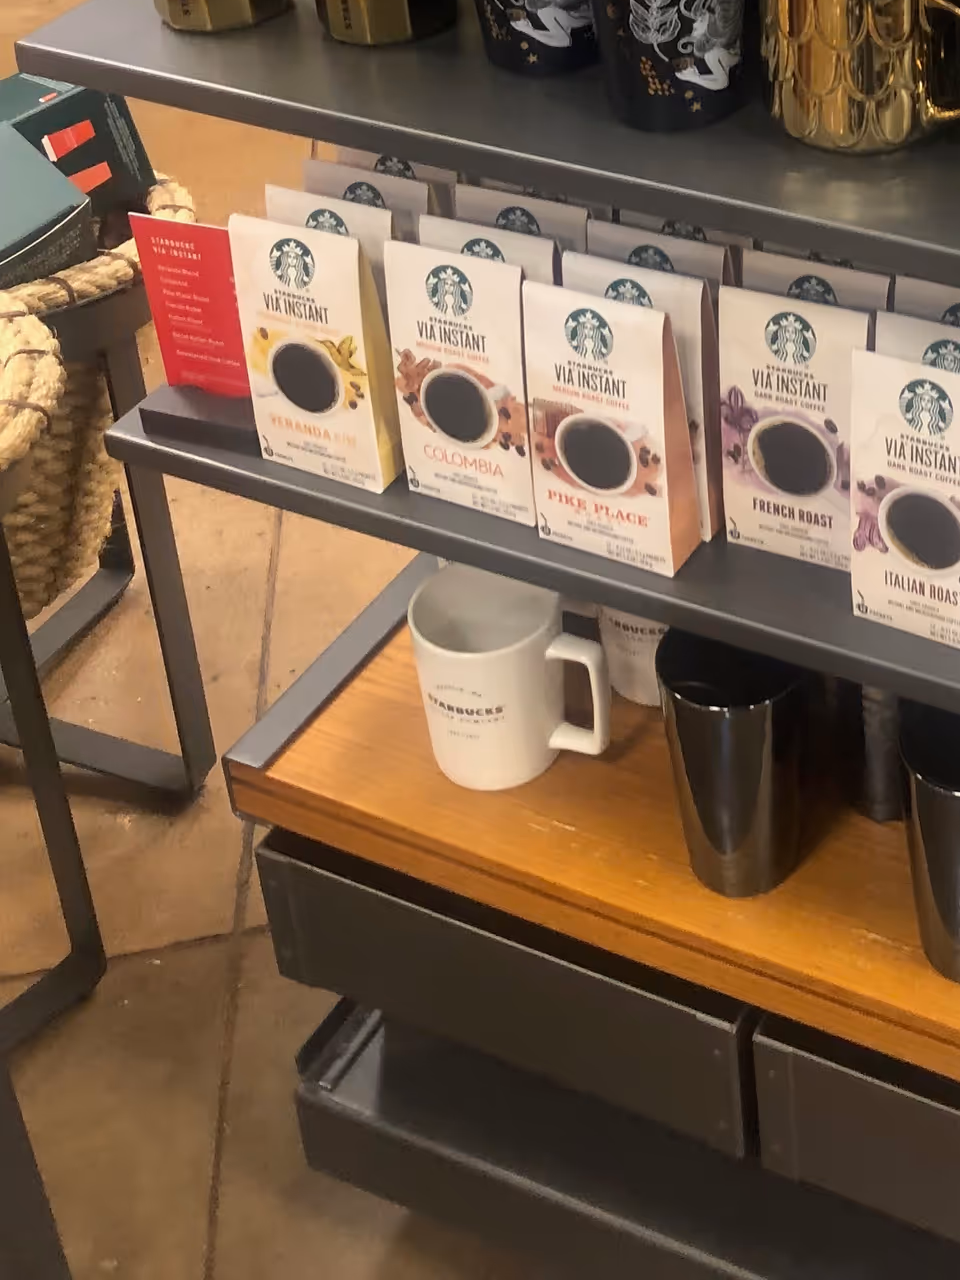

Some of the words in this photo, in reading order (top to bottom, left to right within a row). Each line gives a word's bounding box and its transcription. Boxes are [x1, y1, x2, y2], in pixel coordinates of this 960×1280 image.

[150, 236, 195, 251] STARBUCKS
[170, 249, 201, 261] INSTANT
[263, 292, 282, 313] VIA
[283, 298, 328, 325] INSTANT
[274, 288, 316, 304] STARBUCKS
[429, 316, 473, 331] STARBUCKS
[417, 320, 436, 341] VIA
[439, 325, 486, 353] INSTANT
[568, 360, 613, 376] STARBUCKS
[766, 364, 814, 380] STARBUCKS
[555, 363, 575, 386] VIA
[578, 370, 626, 399] INSTANT
[752, 368, 773, 391] VIA
[776, 373, 828, 402] INSTANT
[800, 400, 826, 413] COFFEE
[270, 414, 331, 441] VERANDA
[885, 436, 906, 460] VIA
[900, 433, 950, 452] STARBUCKS
[423, 444, 504, 478] COLOMBIA
[887, 460, 906, 471] DARK
[909, 466, 932, 478] ROAST
[935, 473, 960, 487] COFFEE
[548, 489, 587, 511] PIKE
[594, 502, 649, 528] PLACE
[752, 497, 795, 520] FRENCH
[798, 508, 833, 529] ROAST
[884, 570, 925, 597] ITALIAN
[428, 693, 504, 717] STARBUCKS
